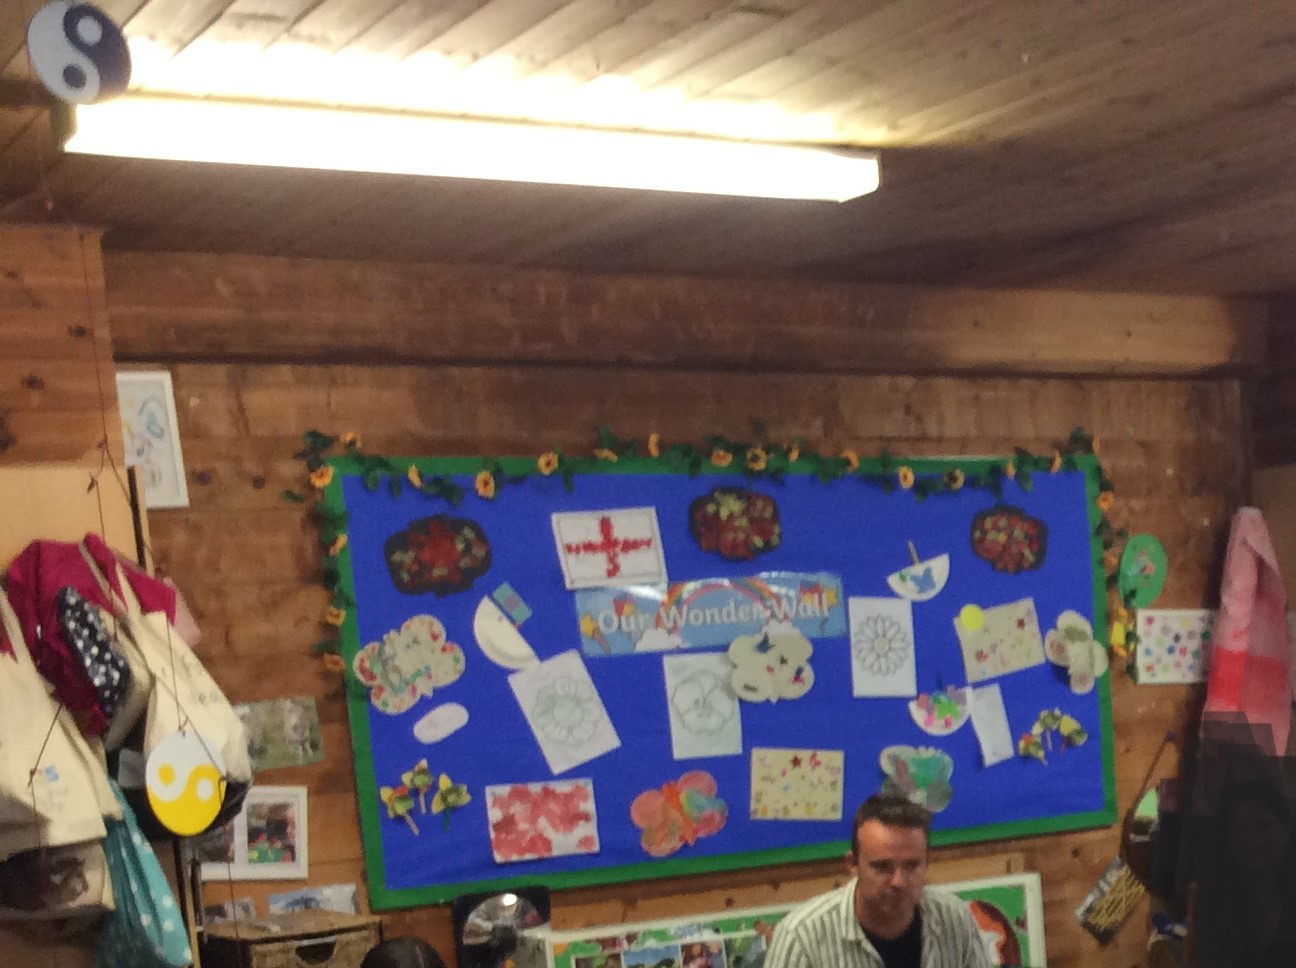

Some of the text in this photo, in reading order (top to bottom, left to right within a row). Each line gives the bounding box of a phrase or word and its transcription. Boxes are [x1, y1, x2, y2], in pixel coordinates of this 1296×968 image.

[599, 598, 829, 635] Our Wonder Wall
